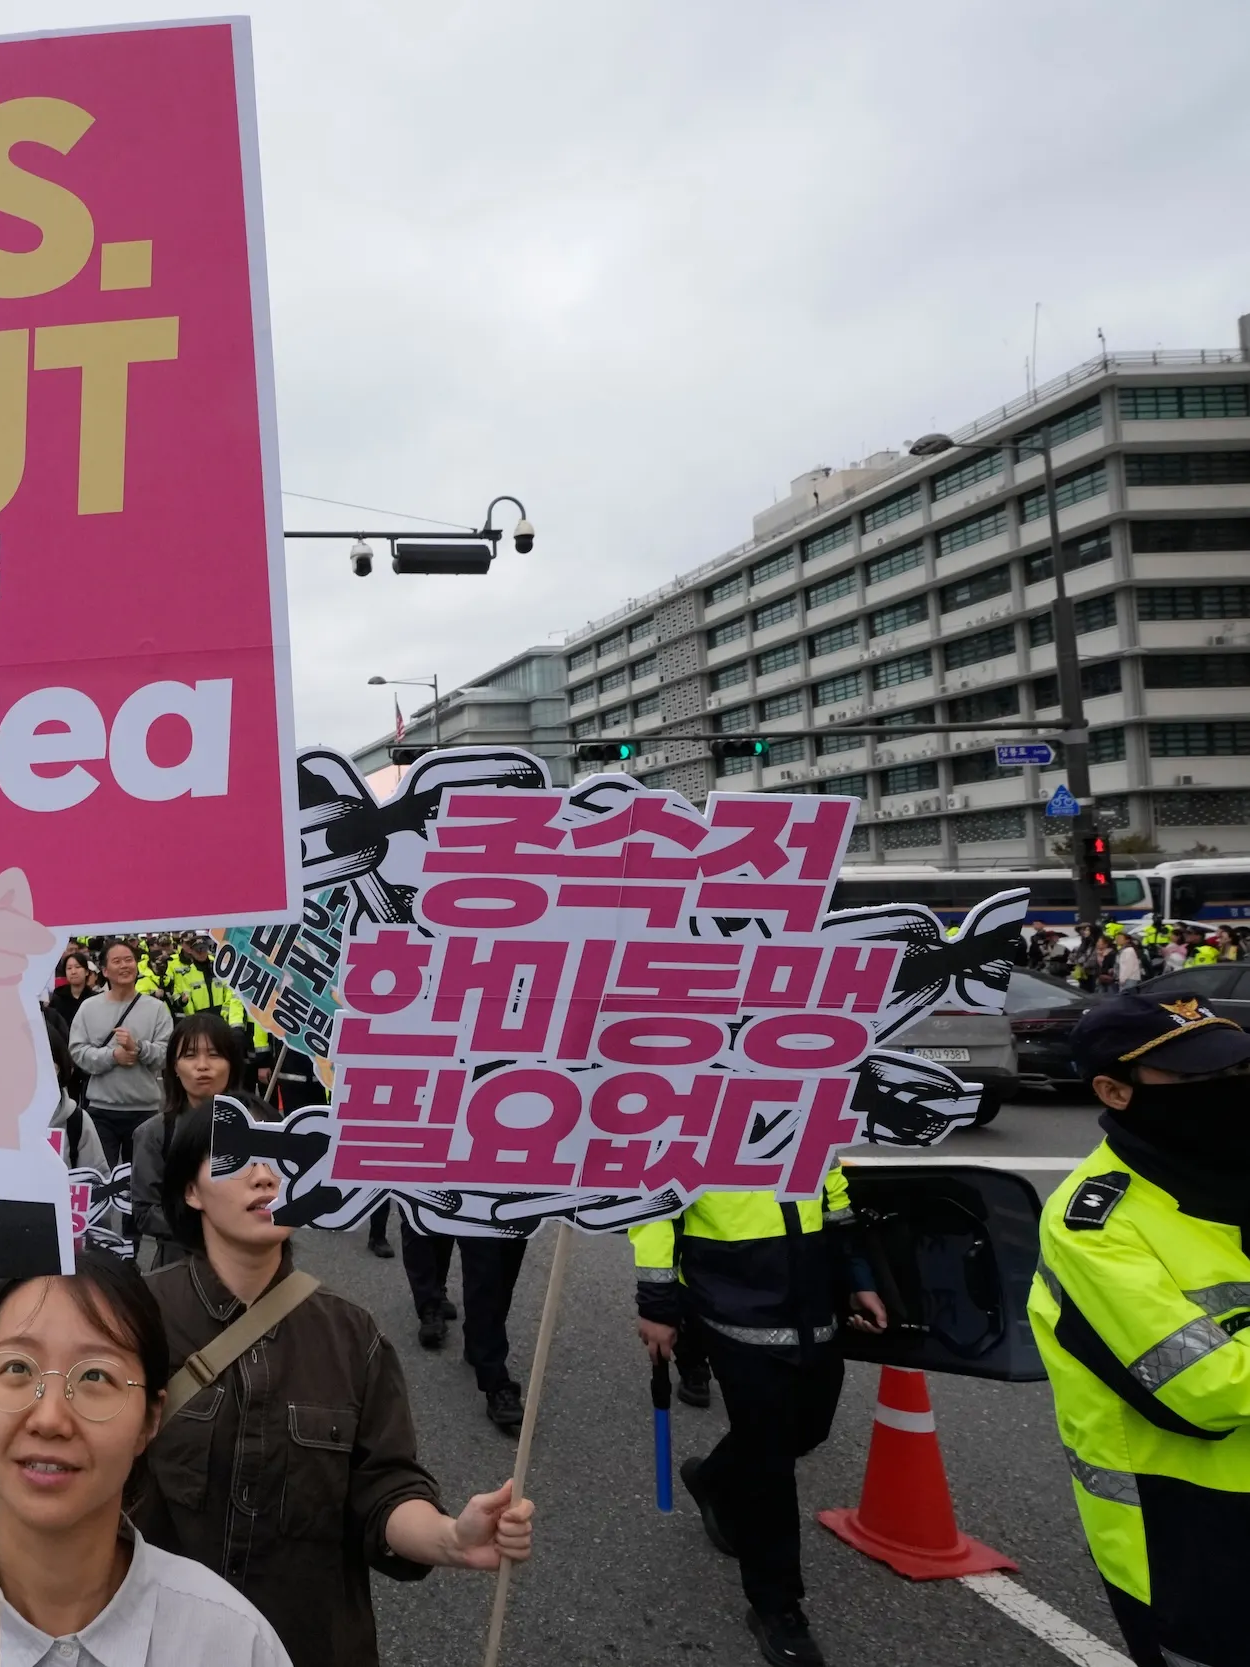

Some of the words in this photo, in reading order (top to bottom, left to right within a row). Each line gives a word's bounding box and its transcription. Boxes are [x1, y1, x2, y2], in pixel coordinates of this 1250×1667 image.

[421, 795, 851, 932] 종속적
[215, 944, 279, 1011] 이게
[337, 930, 905, 1070] 한미동맹
[943, 1049, 967, 1060] 9381
[330, 1067, 859, 1195] 필요없다
